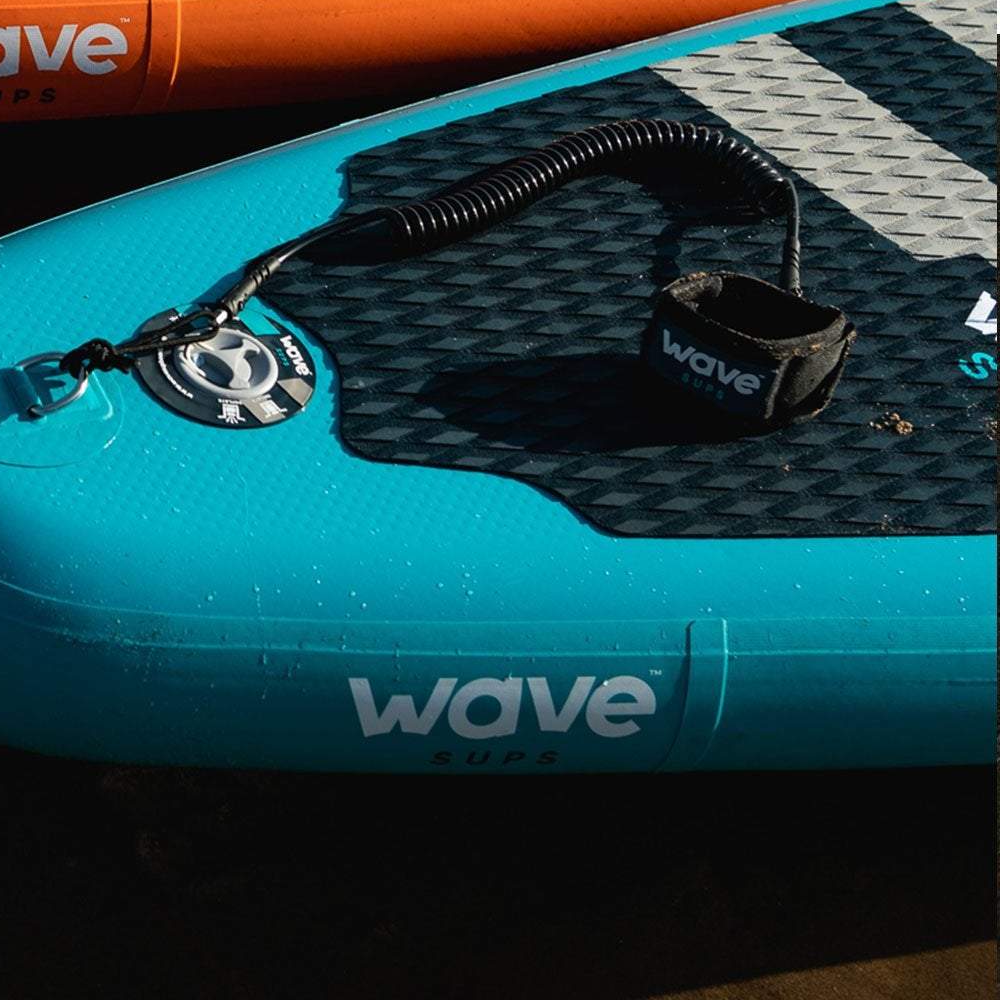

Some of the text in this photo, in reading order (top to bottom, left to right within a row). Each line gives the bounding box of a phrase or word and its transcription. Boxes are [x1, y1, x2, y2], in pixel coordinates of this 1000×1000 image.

[280, 334, 310, 376] wave
[663, 328, 761, 395] wave
[348, 675, 657, 740] wave
[430, 750, 560, 766] SUPS
